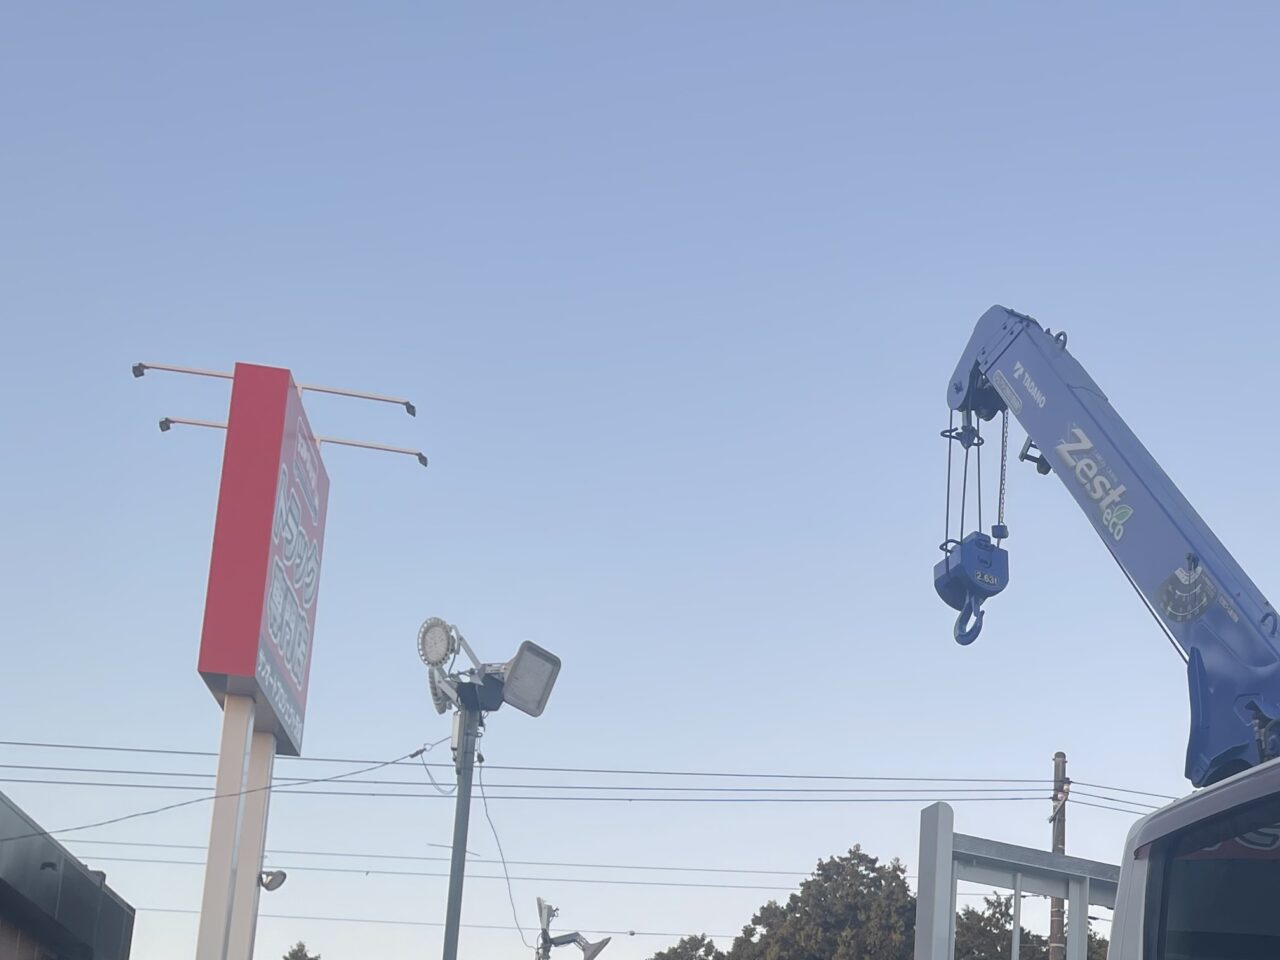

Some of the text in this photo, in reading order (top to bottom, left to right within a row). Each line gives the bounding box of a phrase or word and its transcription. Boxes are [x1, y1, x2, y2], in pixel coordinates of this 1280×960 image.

[1023, 373, 1046, 409] TADANO
[1056, 428, 1127, 511] Zest
[272, 464, 320, 608] トラック
[1103, 510, 1124, 541] eco
[269, 556, 309, 689] 専門店
